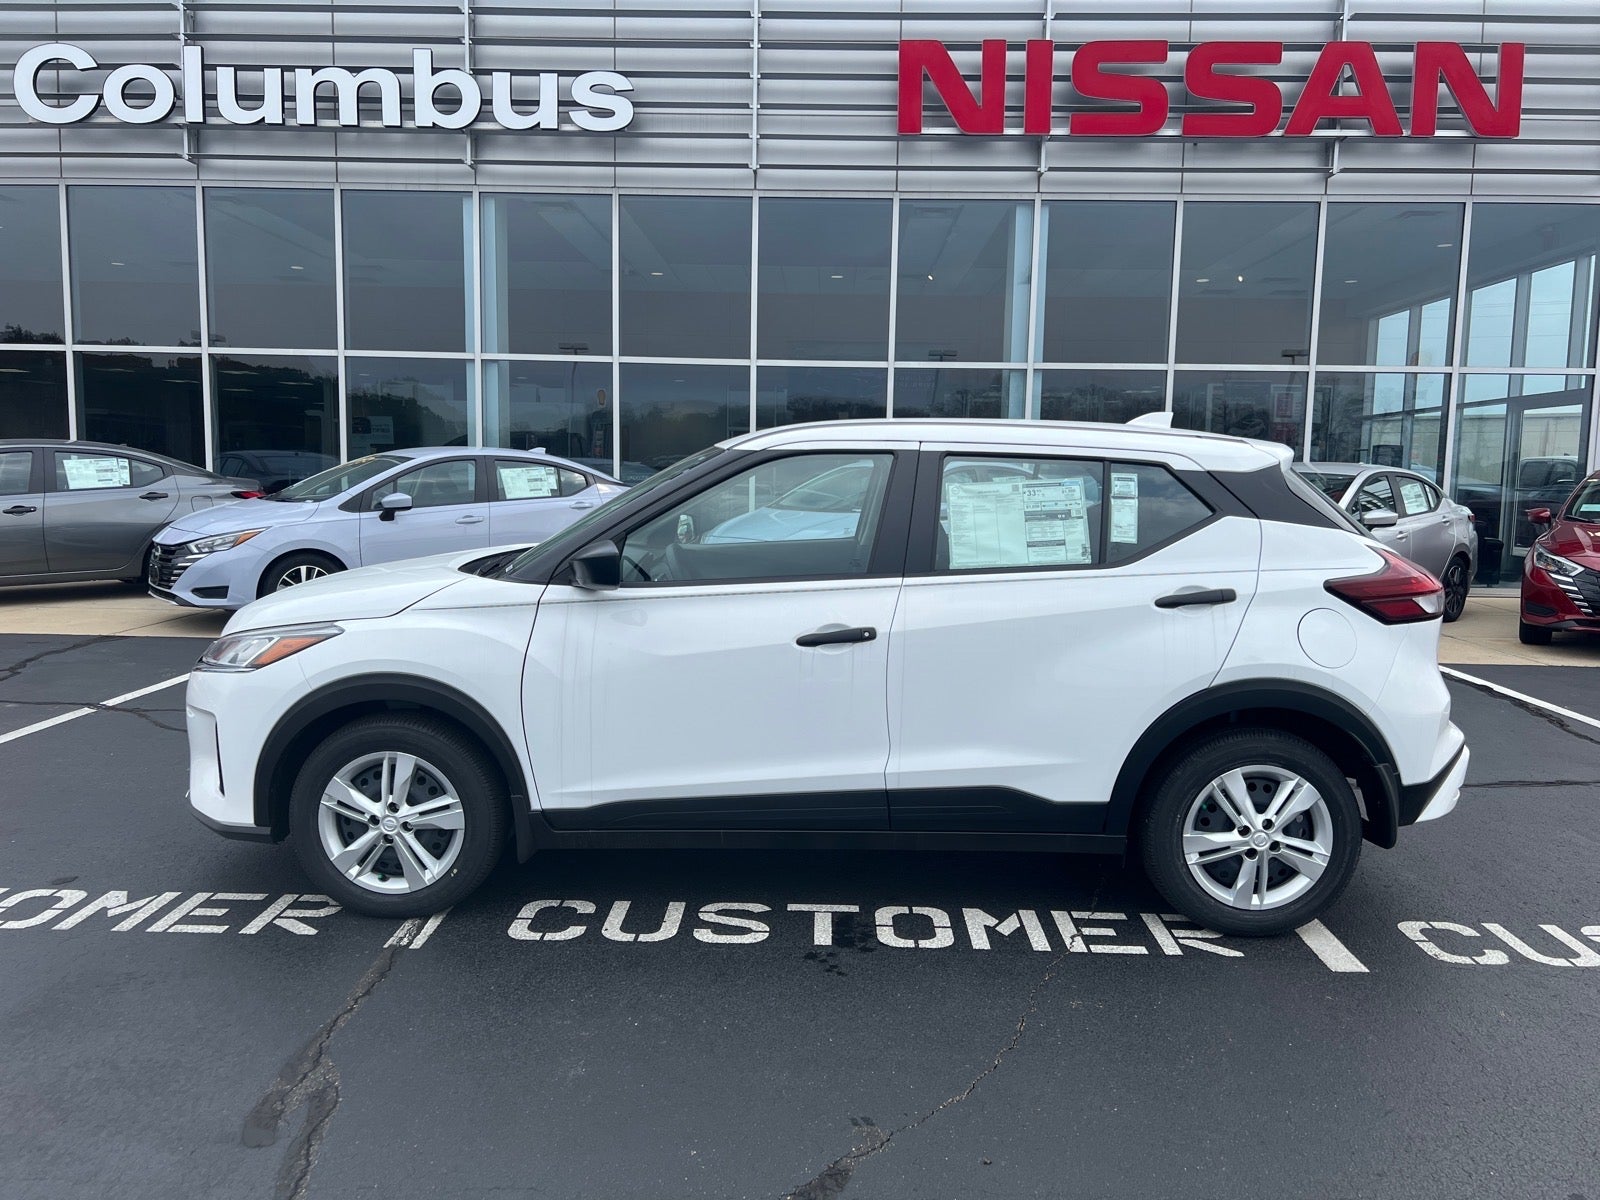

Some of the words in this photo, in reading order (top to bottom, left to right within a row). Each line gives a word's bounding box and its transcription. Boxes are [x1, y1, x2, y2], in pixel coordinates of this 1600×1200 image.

[13, 42, 635, 133] Columbus
[897, 39, 1524, 138] NISSAN
[0, 887, 343, 936] OMER
[507, 899, 1244, 958] CUSTOMER
